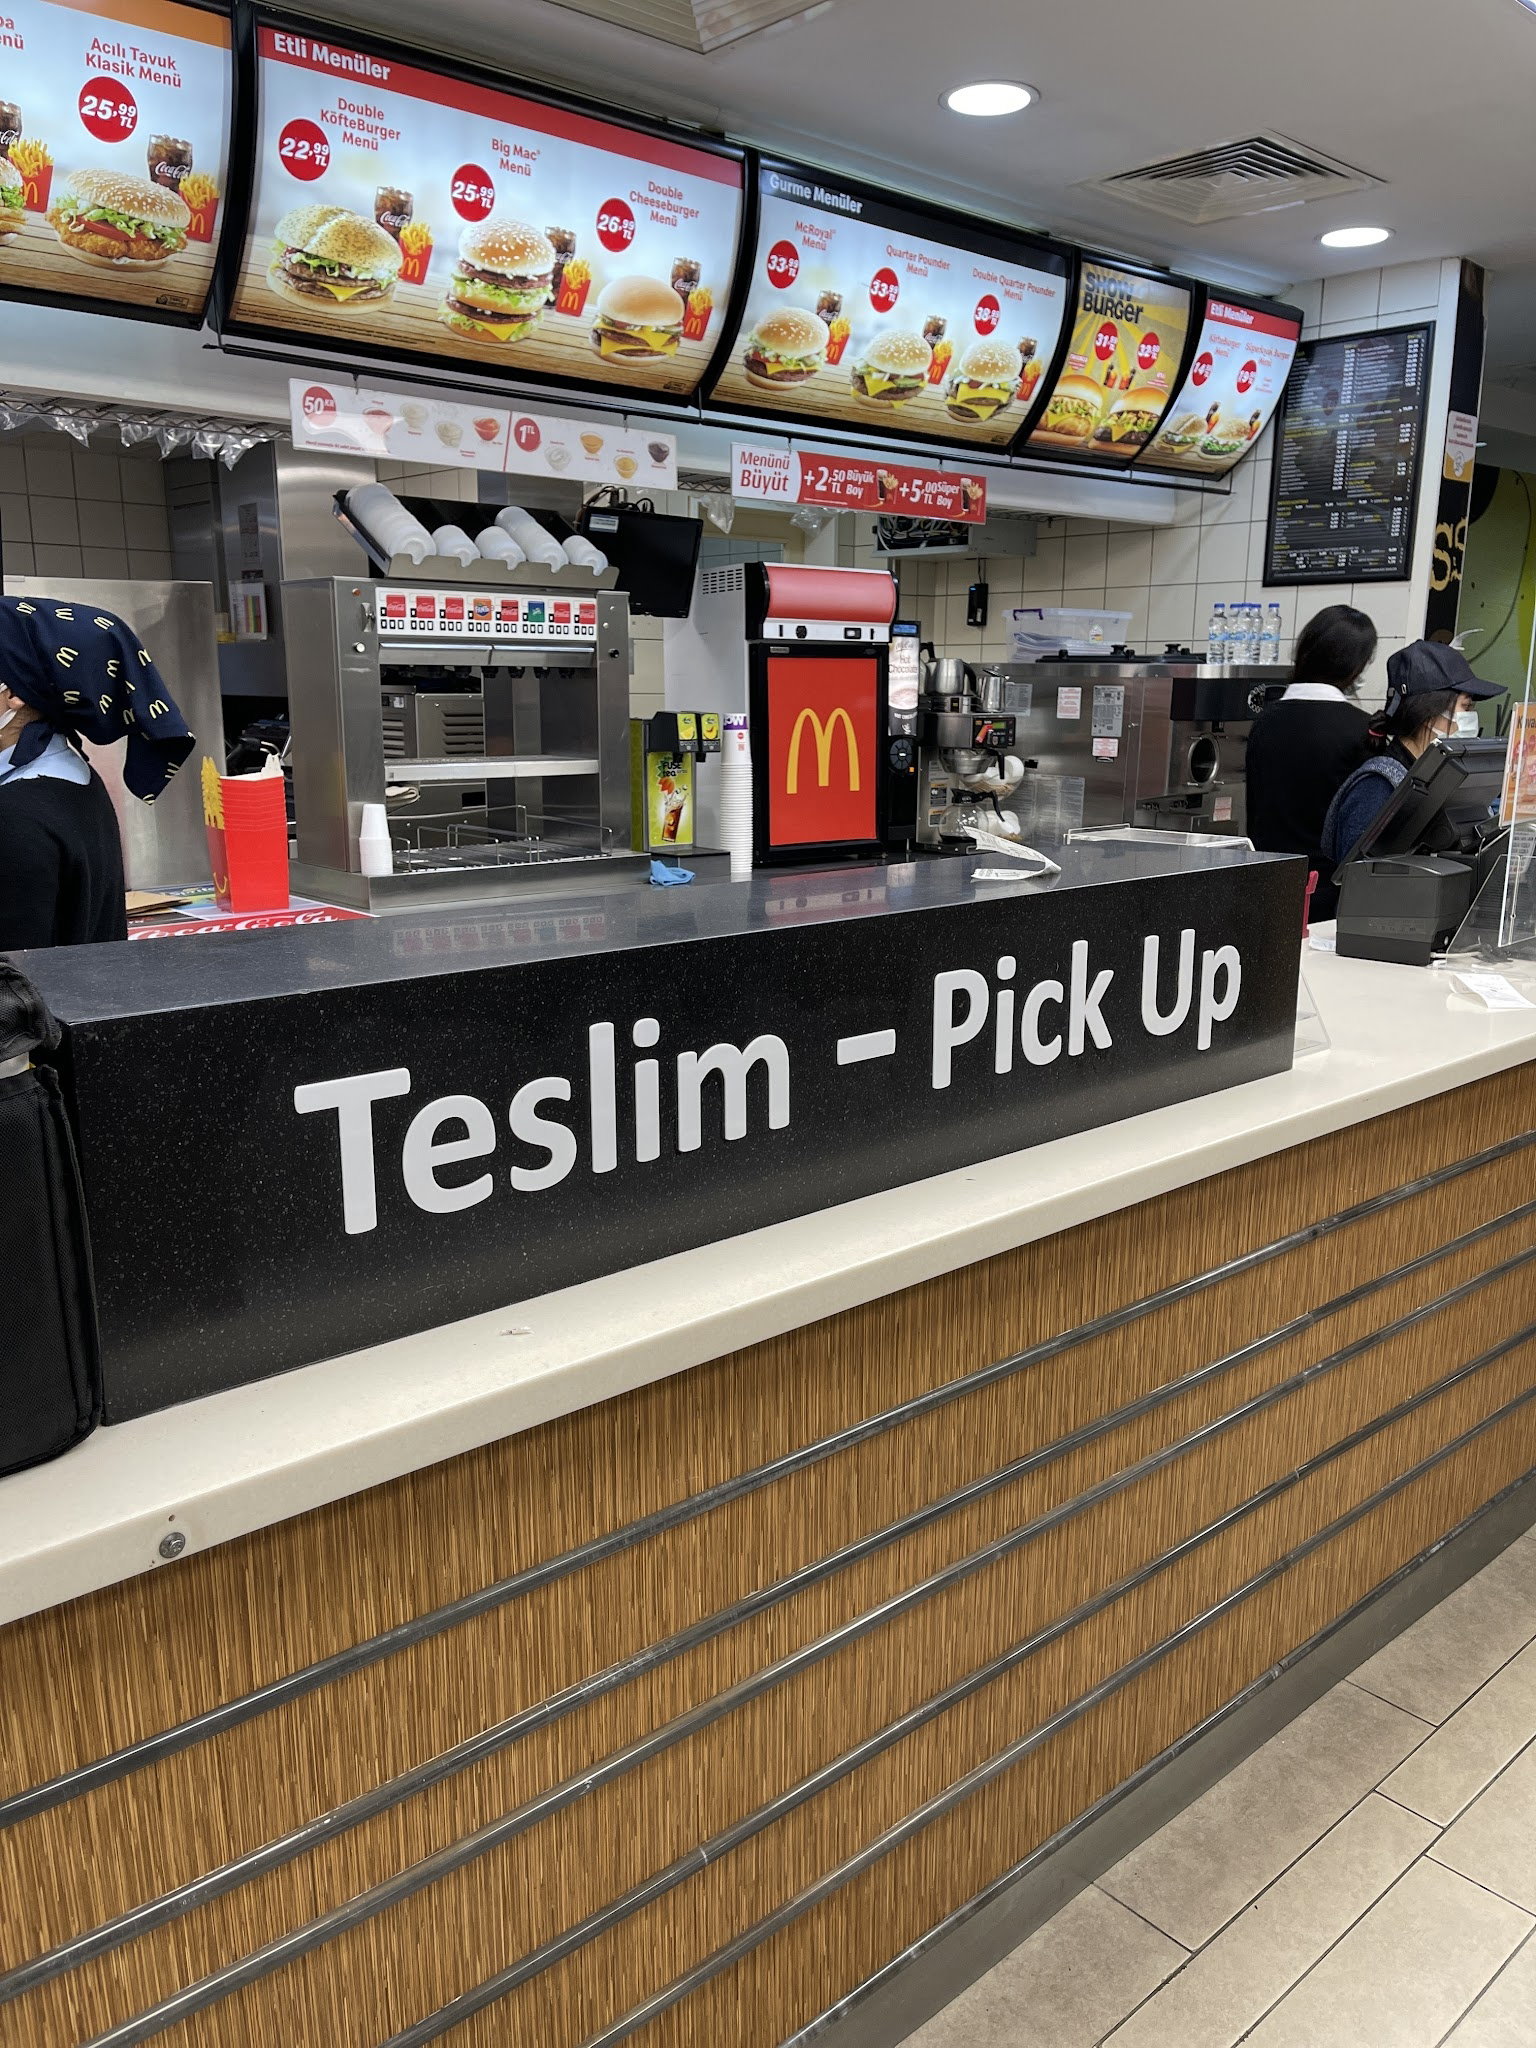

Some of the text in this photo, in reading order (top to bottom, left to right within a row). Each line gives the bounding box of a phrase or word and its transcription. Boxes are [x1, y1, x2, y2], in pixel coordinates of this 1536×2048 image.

[91, 37, 176, 70] Acılı Tavuk
[274, 33, 391, 80] Etli Menüler
[85, 52, 182, 88] Klasik Menü
[80, 95, 137, 120] 25,99
[337, 97, 385, 120] Double
[119, 115, 134, 129] TL
[320, 109, 401, 140] KöfteBurger
[280, 137, 329, 160] 22,99
[342, 131, 379, 151] Menü
[491, 138, 510, 158] Big
[314, 154, 328, 166] TL
[499, 158, 532, 177] Menü
[452, 180, 495, 202] 25,99
[647, 181, 684, 201] Double
[769, 175, 863, 214] Gurme Menüler
[480, 195, 492, 209] TL
[629, 190, 700, 219] Cheeseburger
[596, 212, 635, 232] 26,99
[649, 210, 678, 228] Menü
[622, 228, 633, 240] TL
[802, 236, 827, 251] Menü
[886, 244, 950, 272] Quarter Pounder
[906, 263, 929, 278] Menü
[972, 267, 1056, 298] Double Quarter Pounder
[739, 450, 791, 470] Menünü
[739, 468, 789, 495] Büyüt
[846, 468, 874, 484] Büyük
[831, 482, 864, 499] TL Boy
[937, 481, 960, 498] Süper
[923, 494, 953, 509] TL Boy
[294, 1020, 792, 1235] Teslim
[931, 939, 1115, 1090] Pick
[1141, 928, 1242, 1051] Up
